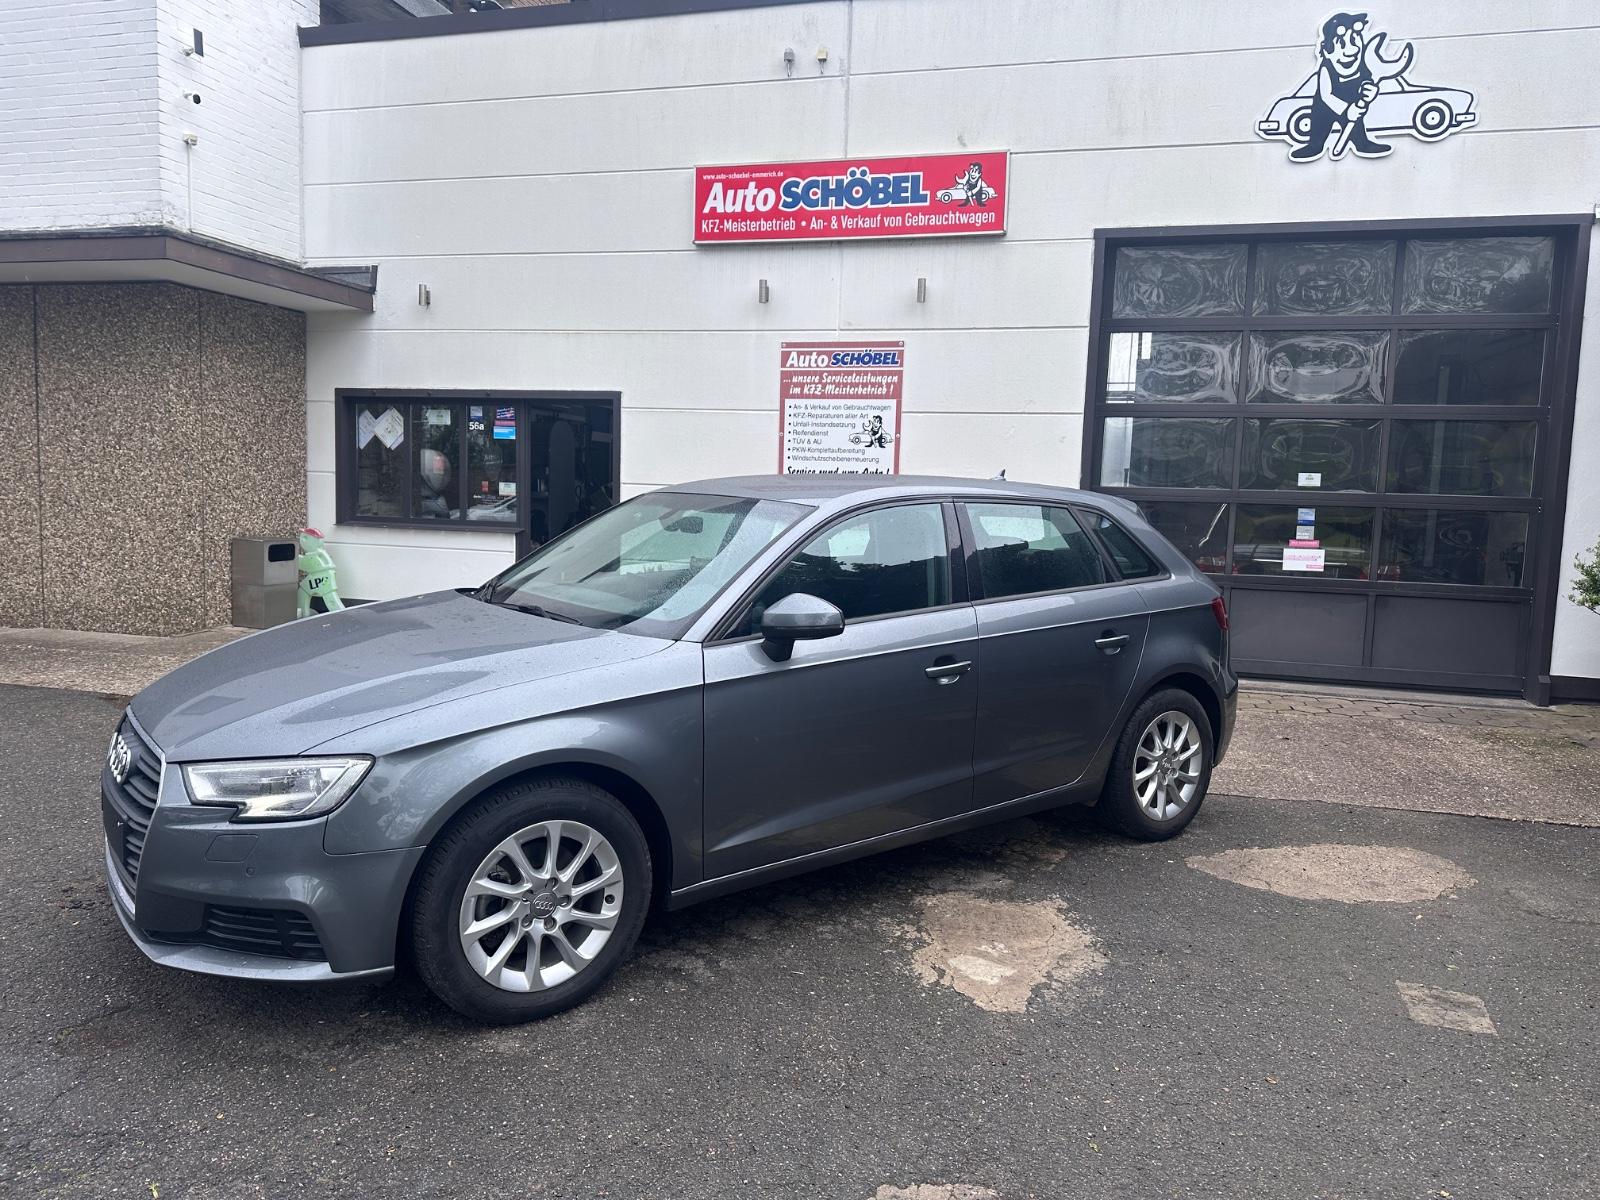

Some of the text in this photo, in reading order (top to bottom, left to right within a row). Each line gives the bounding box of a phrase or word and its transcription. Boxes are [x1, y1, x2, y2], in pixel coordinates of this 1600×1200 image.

[702, 167, 930, 213] Auto SCHÖBEL
[701, 211, 995, 233] KFZ-Meisterbetrieb An- & Verkauf von Gebrauchtwagen
[786, 349, 899, 367] Auto SCHÖBEL
[821, 373, 899, 386] Serviceleistungen
[789, 385, 801, 394] im
[803, 384, 887, 395] KFZ-Meisterbetrieb
[843, 404, 892, 412] Gebrauchtwagen
[793, 412, 844, 420] KFZ-Reparaturen
[469, 421, 485, 431] 56a
[792, 437, 805, 445] TÜV
